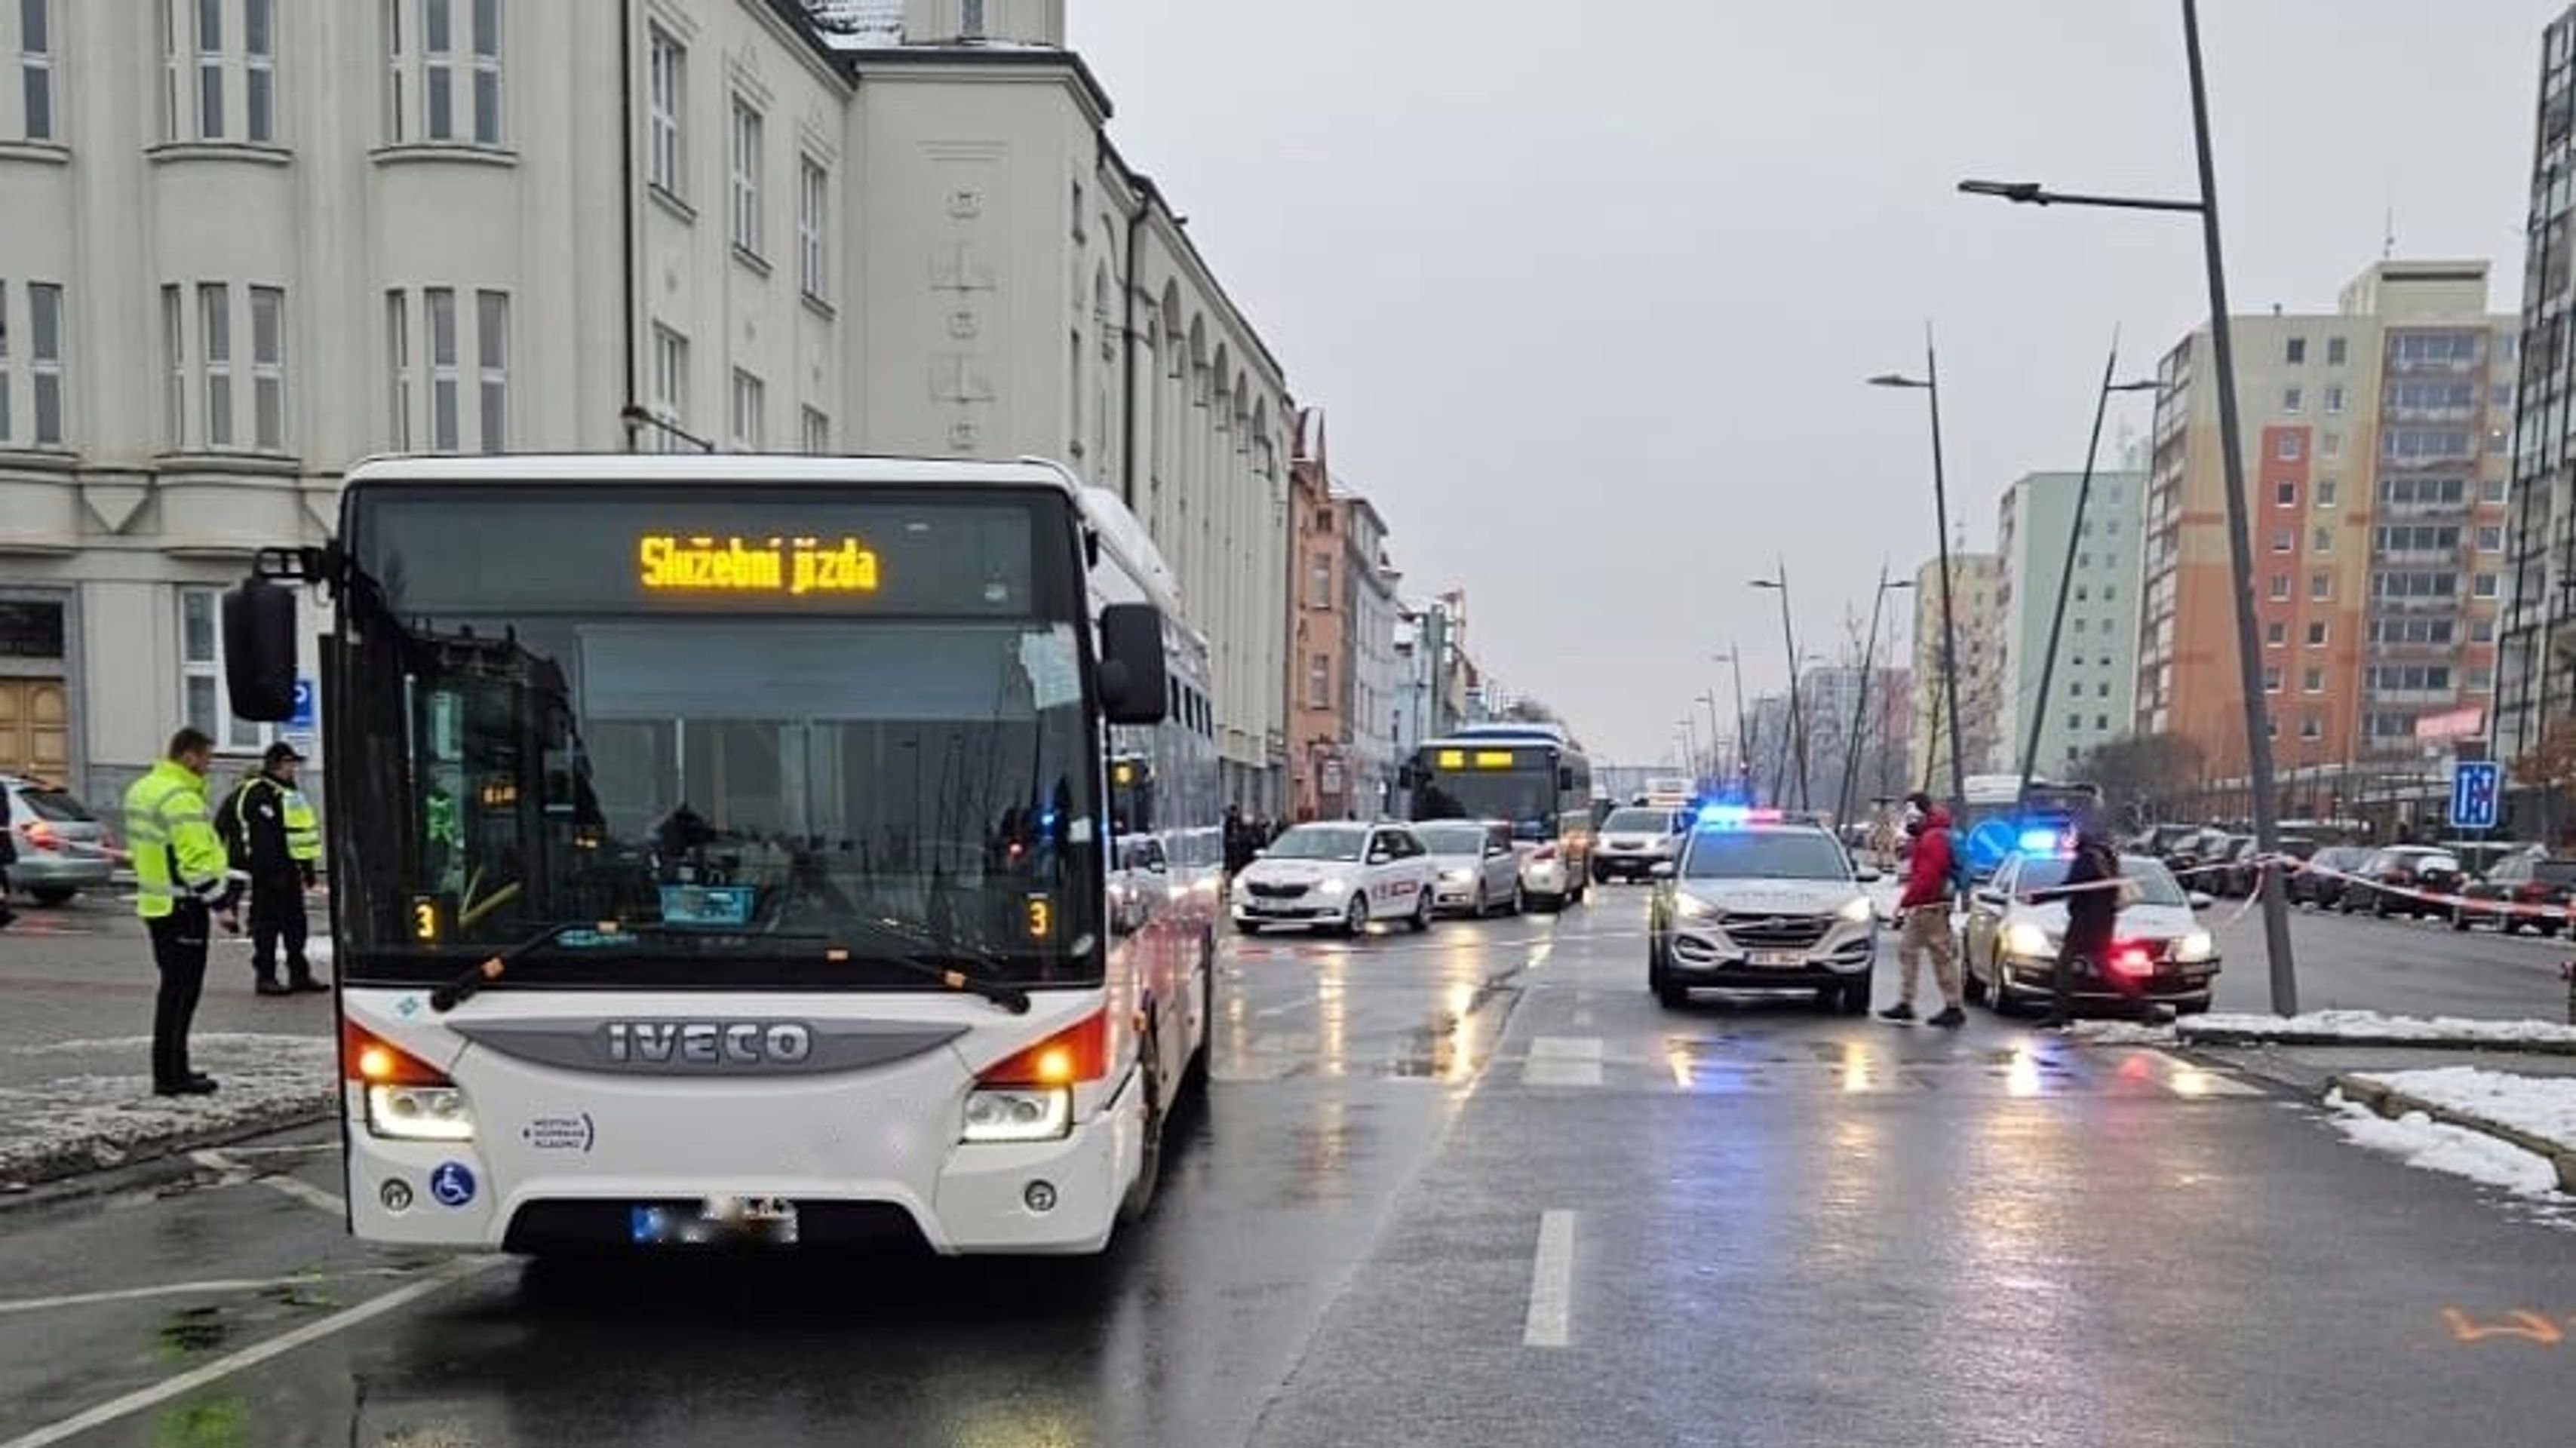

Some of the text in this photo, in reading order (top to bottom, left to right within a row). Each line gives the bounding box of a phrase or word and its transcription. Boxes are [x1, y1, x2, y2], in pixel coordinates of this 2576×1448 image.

[640, 537, 877, 594] Služební jízda
[416, 903, 434, 937] 3
[1030, 901, 1046, 935] 3
[608, 1023, 810, 1061] IVECO
